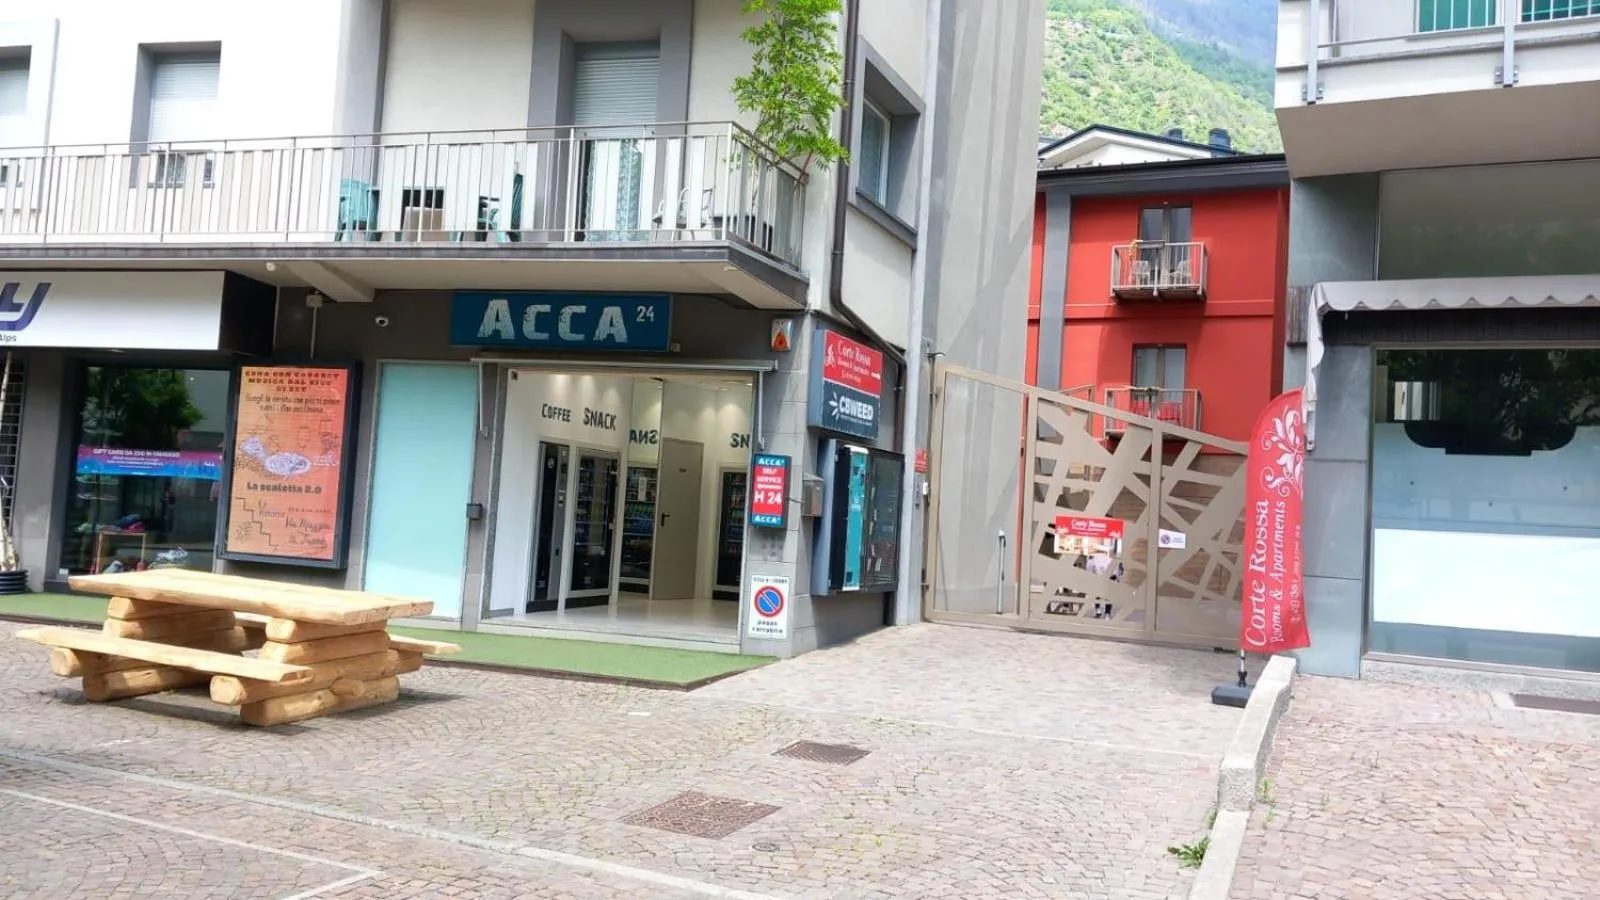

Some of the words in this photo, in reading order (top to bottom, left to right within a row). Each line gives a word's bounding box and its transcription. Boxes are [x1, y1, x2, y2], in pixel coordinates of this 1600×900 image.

[477, 298, 628, 343] ACCA
[636, 305, 655, 322] 24
[541, 403, 571, 422] COFFEE
[583, 407, 617, 431] SNACK
[839, 396, 874, 420] CBWEED
[247, 481, 258, 491] La
[260, 482, 303, 493] scaletta
[304, 485, 322, 494] 2.0
[754, 491, 764, 504] H
[767, 490, 782, 505] 24
[1249, 499, 1269, 574] Rossa
[1269, 501, 1287, 584] Apartments
[1269, 588, 1284, 601] &
[1244, 579, 1267, 646] Corte
[1270, 604, 1285, 643] Rooms
